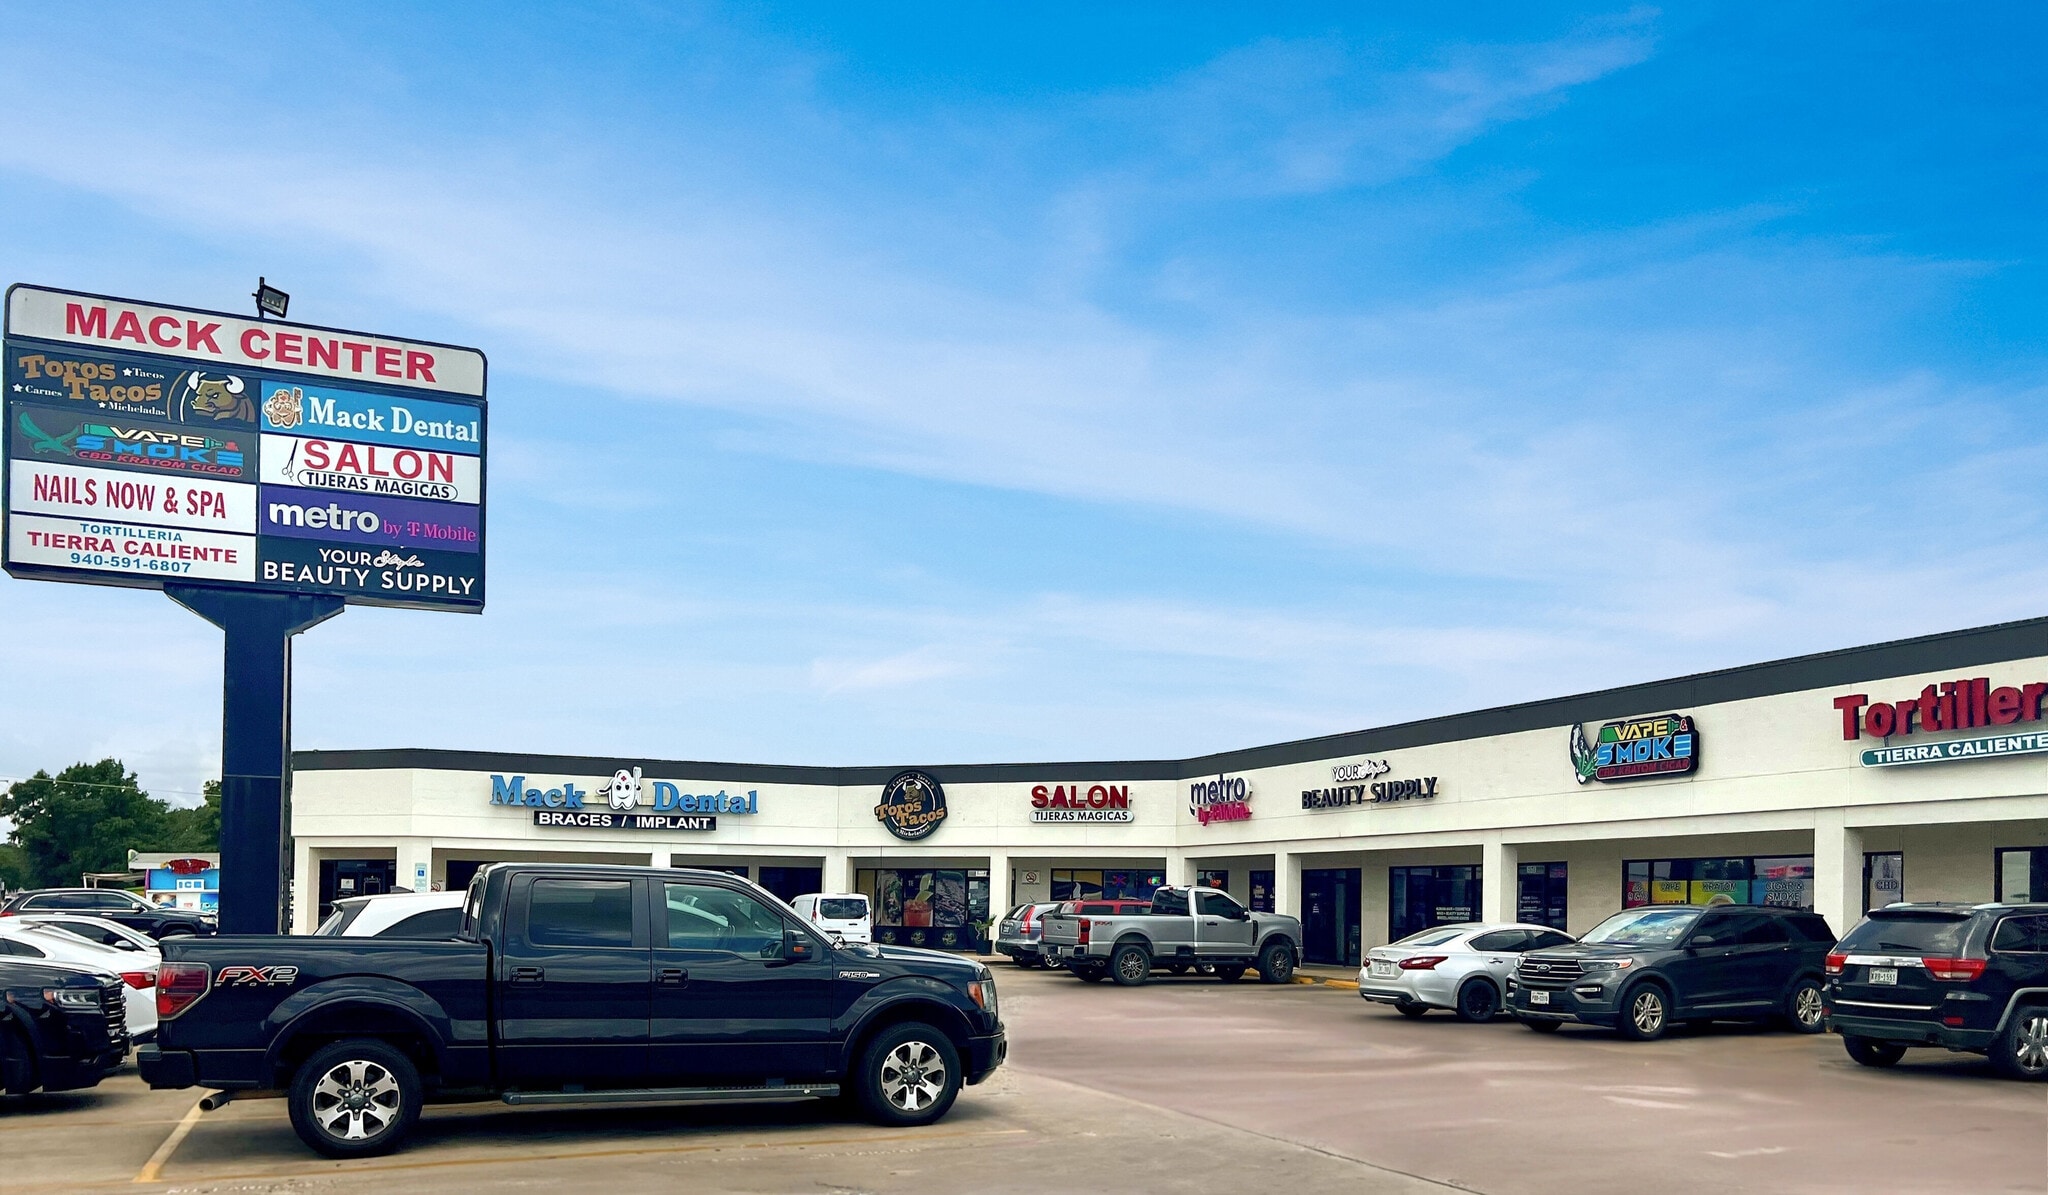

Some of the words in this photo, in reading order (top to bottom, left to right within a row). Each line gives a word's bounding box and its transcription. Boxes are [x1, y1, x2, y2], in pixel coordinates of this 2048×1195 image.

[66, 303, 223, 355] MACK
[240, 328, 437, 383] CENTER
[19, 354, 117, 381] Toros
[132, 368, 165, 380] Tacos
[25, 384, 63, 397] Carnes
[63, 374, 162, 403] Tacos
[108, 400, 166, 417] Micheladas
[308, 396, 385, 432] Mack
[391, 406, 479, 443] Dental
[109, 426, 205, 448] VAPE
[75, 434, 244, 468] SMOKE
[79, 450, 112, 461] CBD
[117, 454, 186, 469] KRATOM
[191, 463, 240, 476] CIGAR
[304, 439, 453, 483] SALON
[34, 473, 97, 506] NAILS
[106, 480, 155, 512] NOW
[163, 486, 179, 514] &
[186, 488, 226, 519] SPA
[306, 471, 369, 490] TIJERAS
[375, 479, 450, 499] MAGICAS
[80, 523, 183, 542] TORTILLERIA
[269, 503, 380, 533] metro
[383, 519, 402, 539] by
[424, 522, 476, 542] Mobile
[27, 531, 116, 554] TIERRA
[124, 540, 238, 564] CALIENTE
[319, 548, 372, 567] YOUR
[373, 550, 425, 571] Style
[70, 552, 191, 574] 940-591-6807
[263, 561, 370, 587] BEAUTY
[381, 571, 475, 595] SUPPLY
[1615, 720, 1668, 741] VAPE
[1680, 719, 1689, 731] &
[1595, 733, 1692, 766] SMOKE
[1874, 744, 1943, 763] TIERRA
[1948, 734, 2048, 757] CALIENTE
[1332, 765, 1359, 781] YOUR
[1618, 762, 1657, 775] KRATOM
[1660, 759, 1689, 771] CIGAR
[489, 774, 586, 810] Mack
[652, 781, 758, 814] Dental
[1031, 785, 1129, 809] SALON
[1190, 773, 1247, 804] metro
[1302, 785, 1365, 809] BEAUTY
[1370, 776, 1438, 804] SUPPLY
[538, 812, 612, 827] BRACES
[636, 816, 710, 830] IMPLANT
[875, 801, 922, 820] Toros
[896, 807, 945, 827] Tacos
[1034, 811, 1075, 821] TIJERAS
[1077, 811, 1128, 821] MAGICAS
[1767, 892, 1800, 902] SMOKE
[215, 966, 299, 983] FX2
